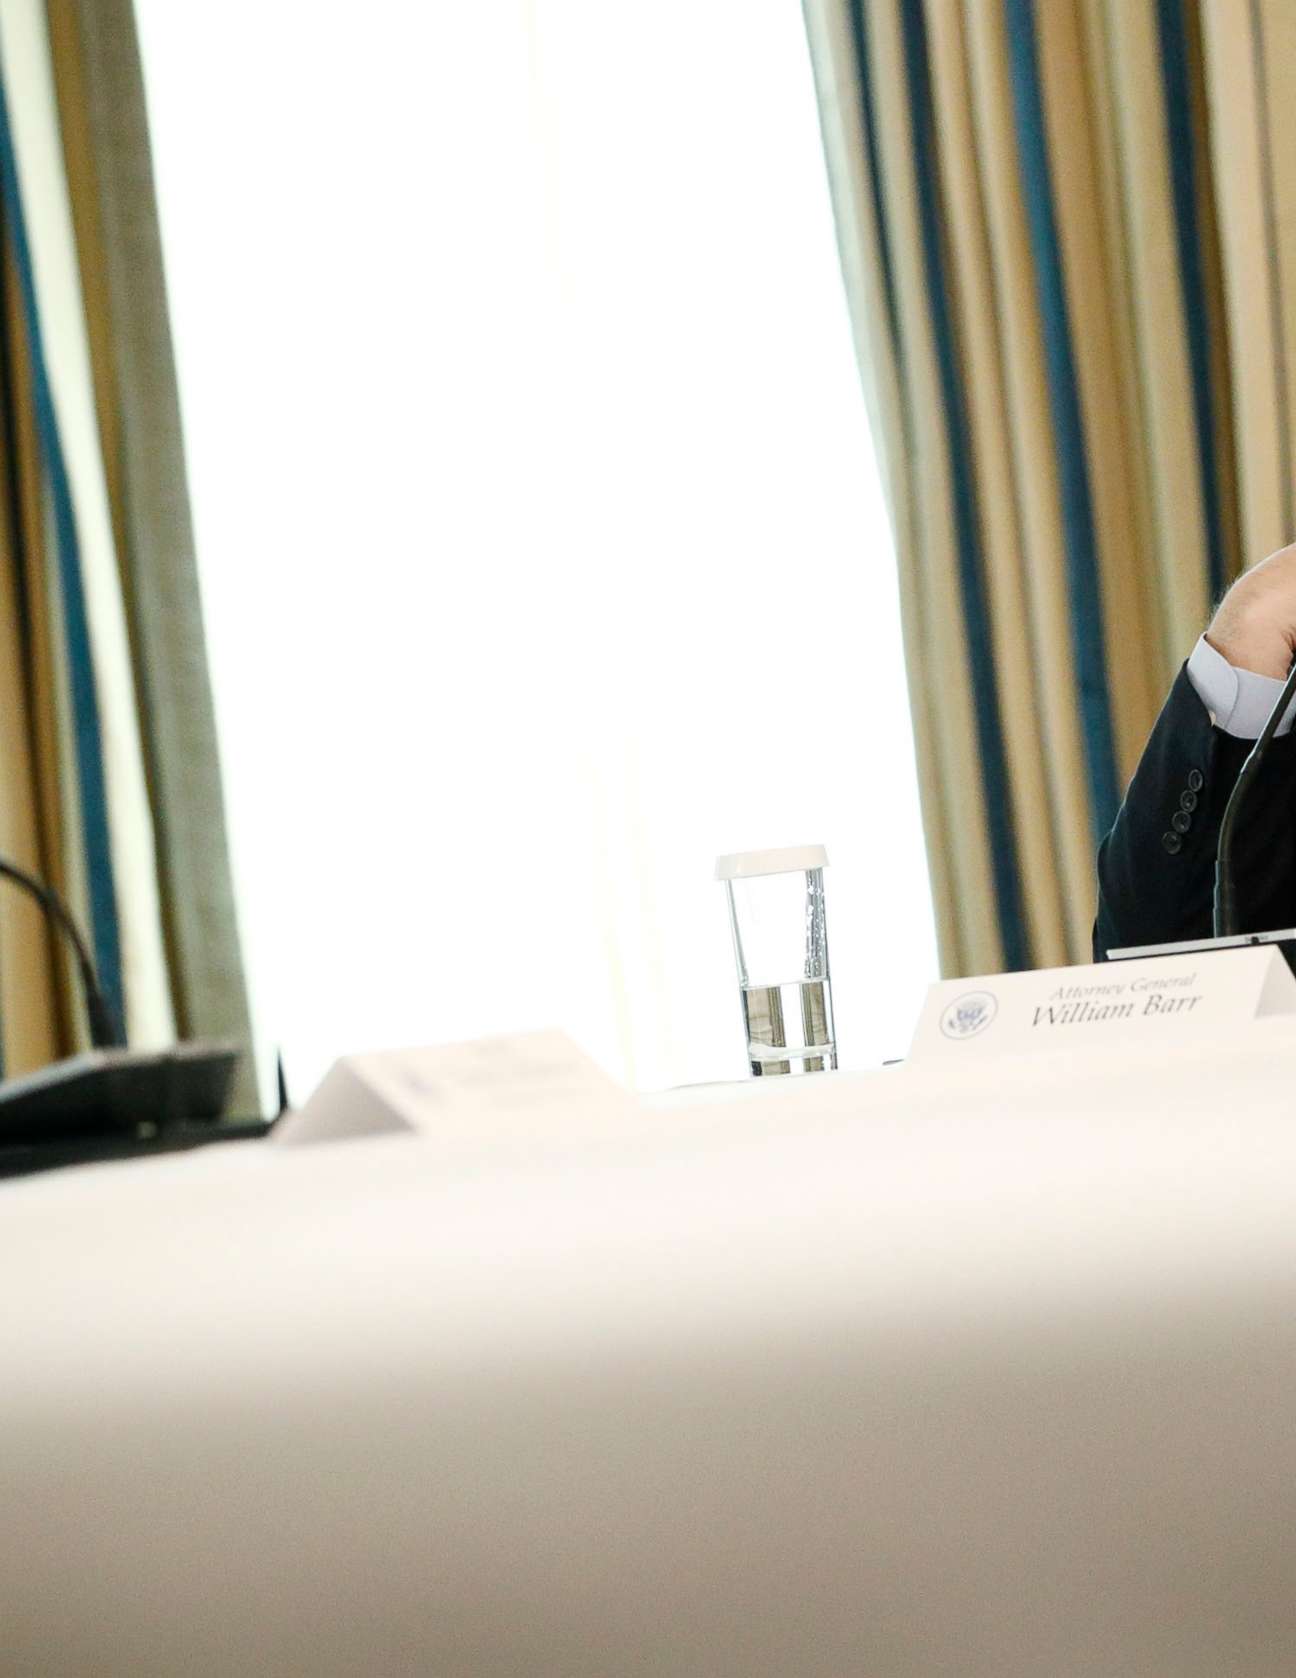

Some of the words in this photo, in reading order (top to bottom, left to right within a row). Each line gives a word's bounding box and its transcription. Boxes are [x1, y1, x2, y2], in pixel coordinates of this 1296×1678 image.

[1051, 982, 1125, 1001] Attorney
[1130, 972, 1198, 993] General
[1032, 1000, 1135, 1027] William
[1142, 993, 1203, 1017] Barr
